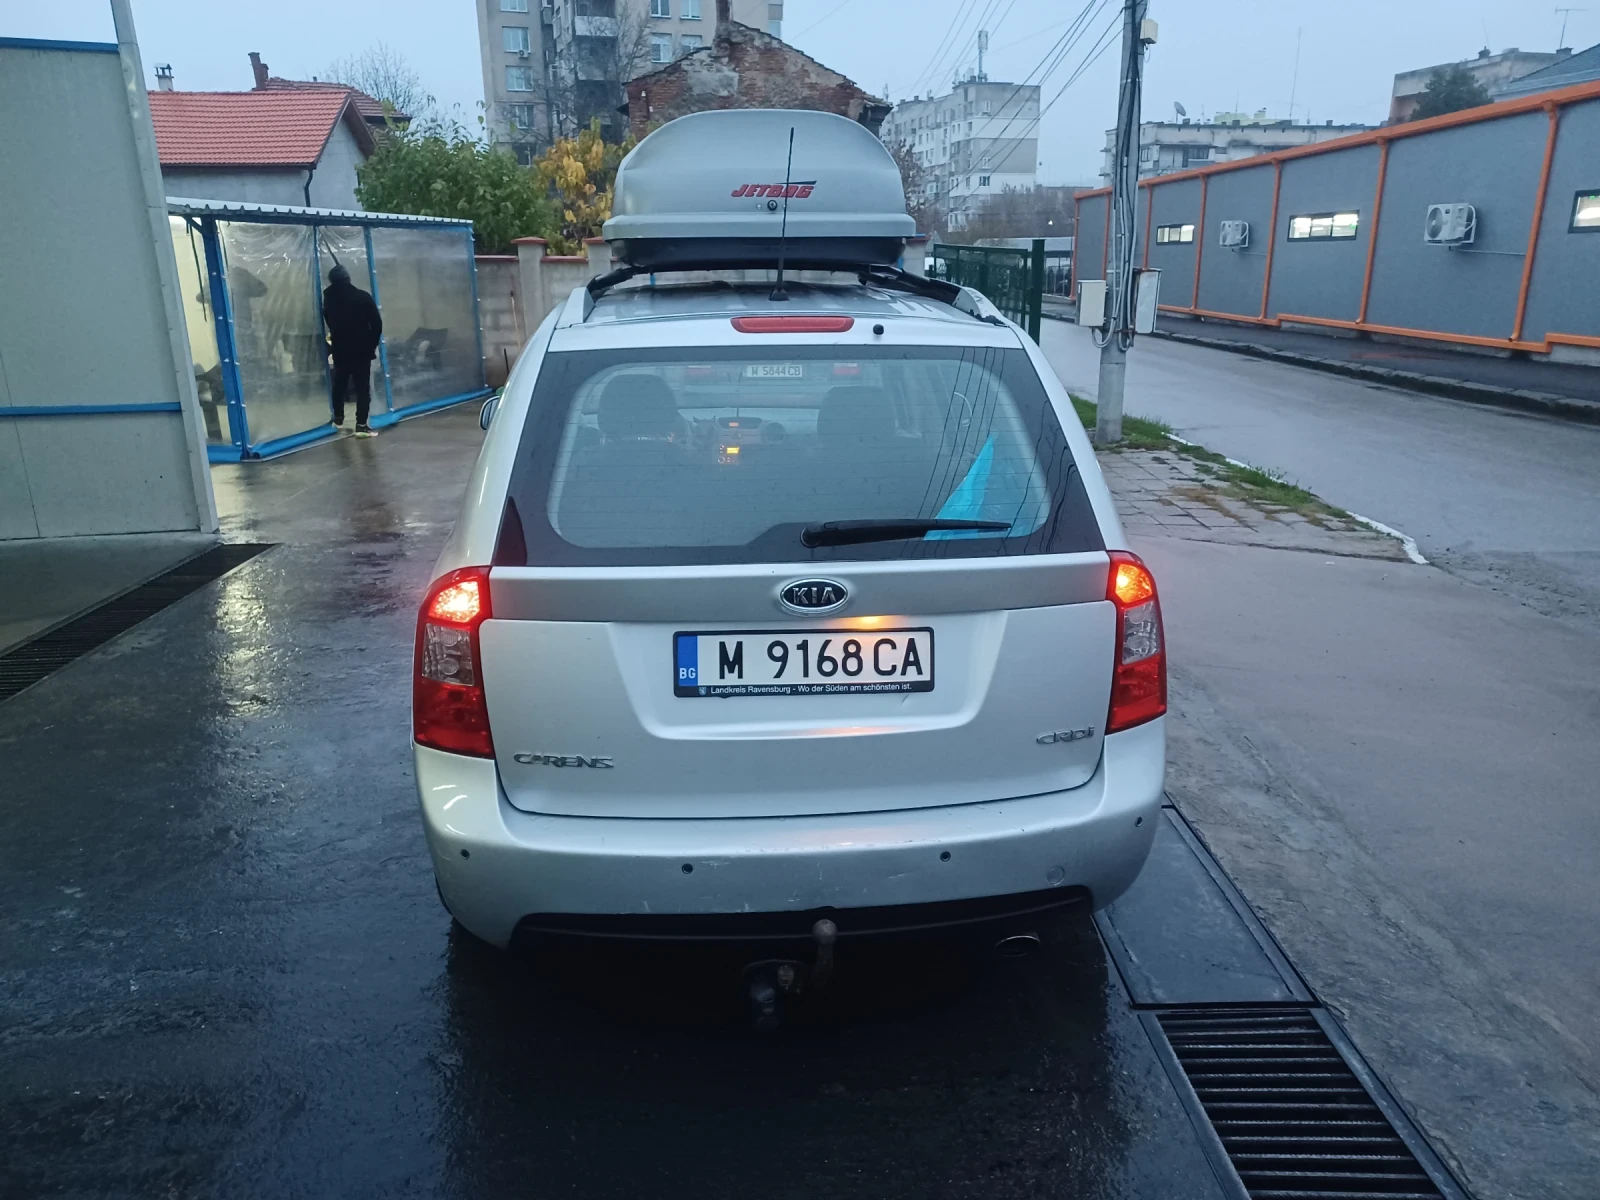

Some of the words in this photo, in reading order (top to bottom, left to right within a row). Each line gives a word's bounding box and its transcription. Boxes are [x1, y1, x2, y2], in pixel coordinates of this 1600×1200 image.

[730, 184, 815, 199] JETBAG
[792, 586, 837, 604] KIA
[718, 640, 743, 680] M
[766, 638, 864, 679] 9168
[872, 637, 924, 677] CA
[679, 667, 696, 680] BG
[710, 686, 746, 695] Landkreis
[747, 685, 791, 695] Ravensburg
[797, 685, 810, 693] Wo
[811, 684, 824, 692] der
[825, 683, 849, 692] Süden
[862, 683, 900, 692] schönsten
[513, 753, 614, 768] CARENS
